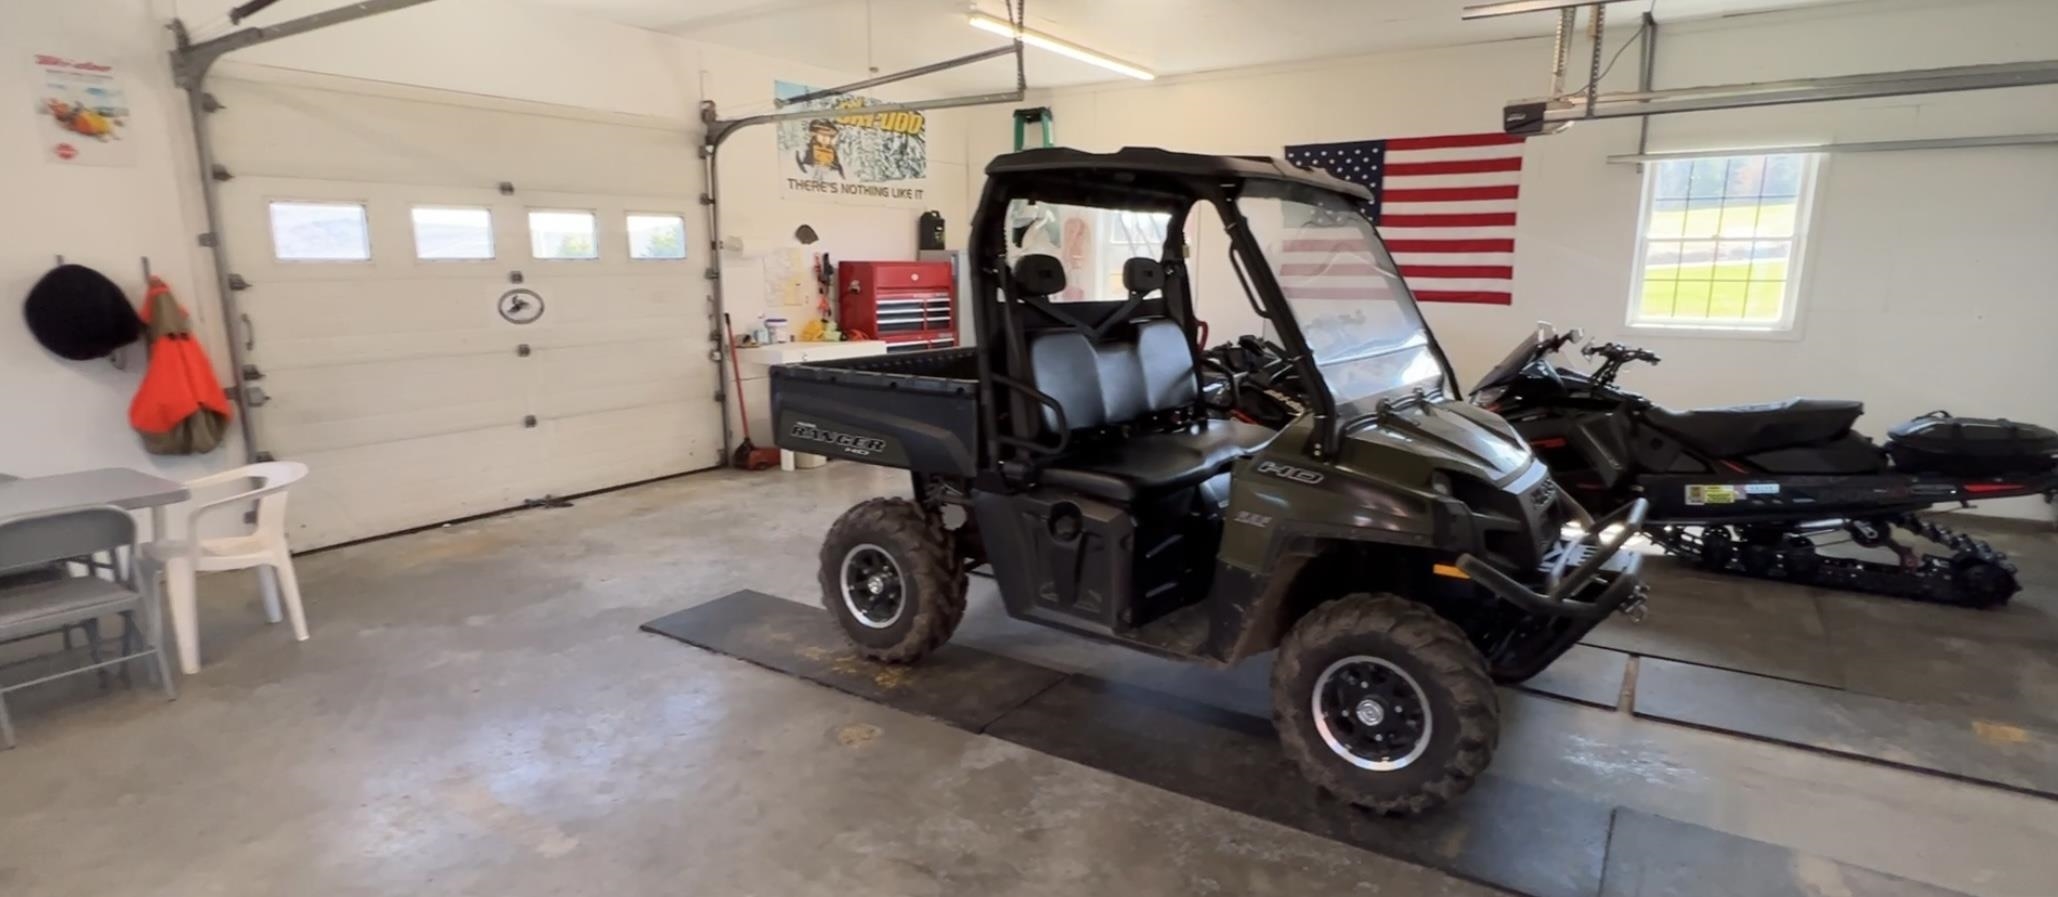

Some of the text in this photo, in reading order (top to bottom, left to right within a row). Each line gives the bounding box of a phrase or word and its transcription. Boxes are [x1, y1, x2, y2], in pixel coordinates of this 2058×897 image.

[787, 178, 924, 200] THERE'S NOTHING LIKE IT
[791, 425, 886, 452] RANGER
